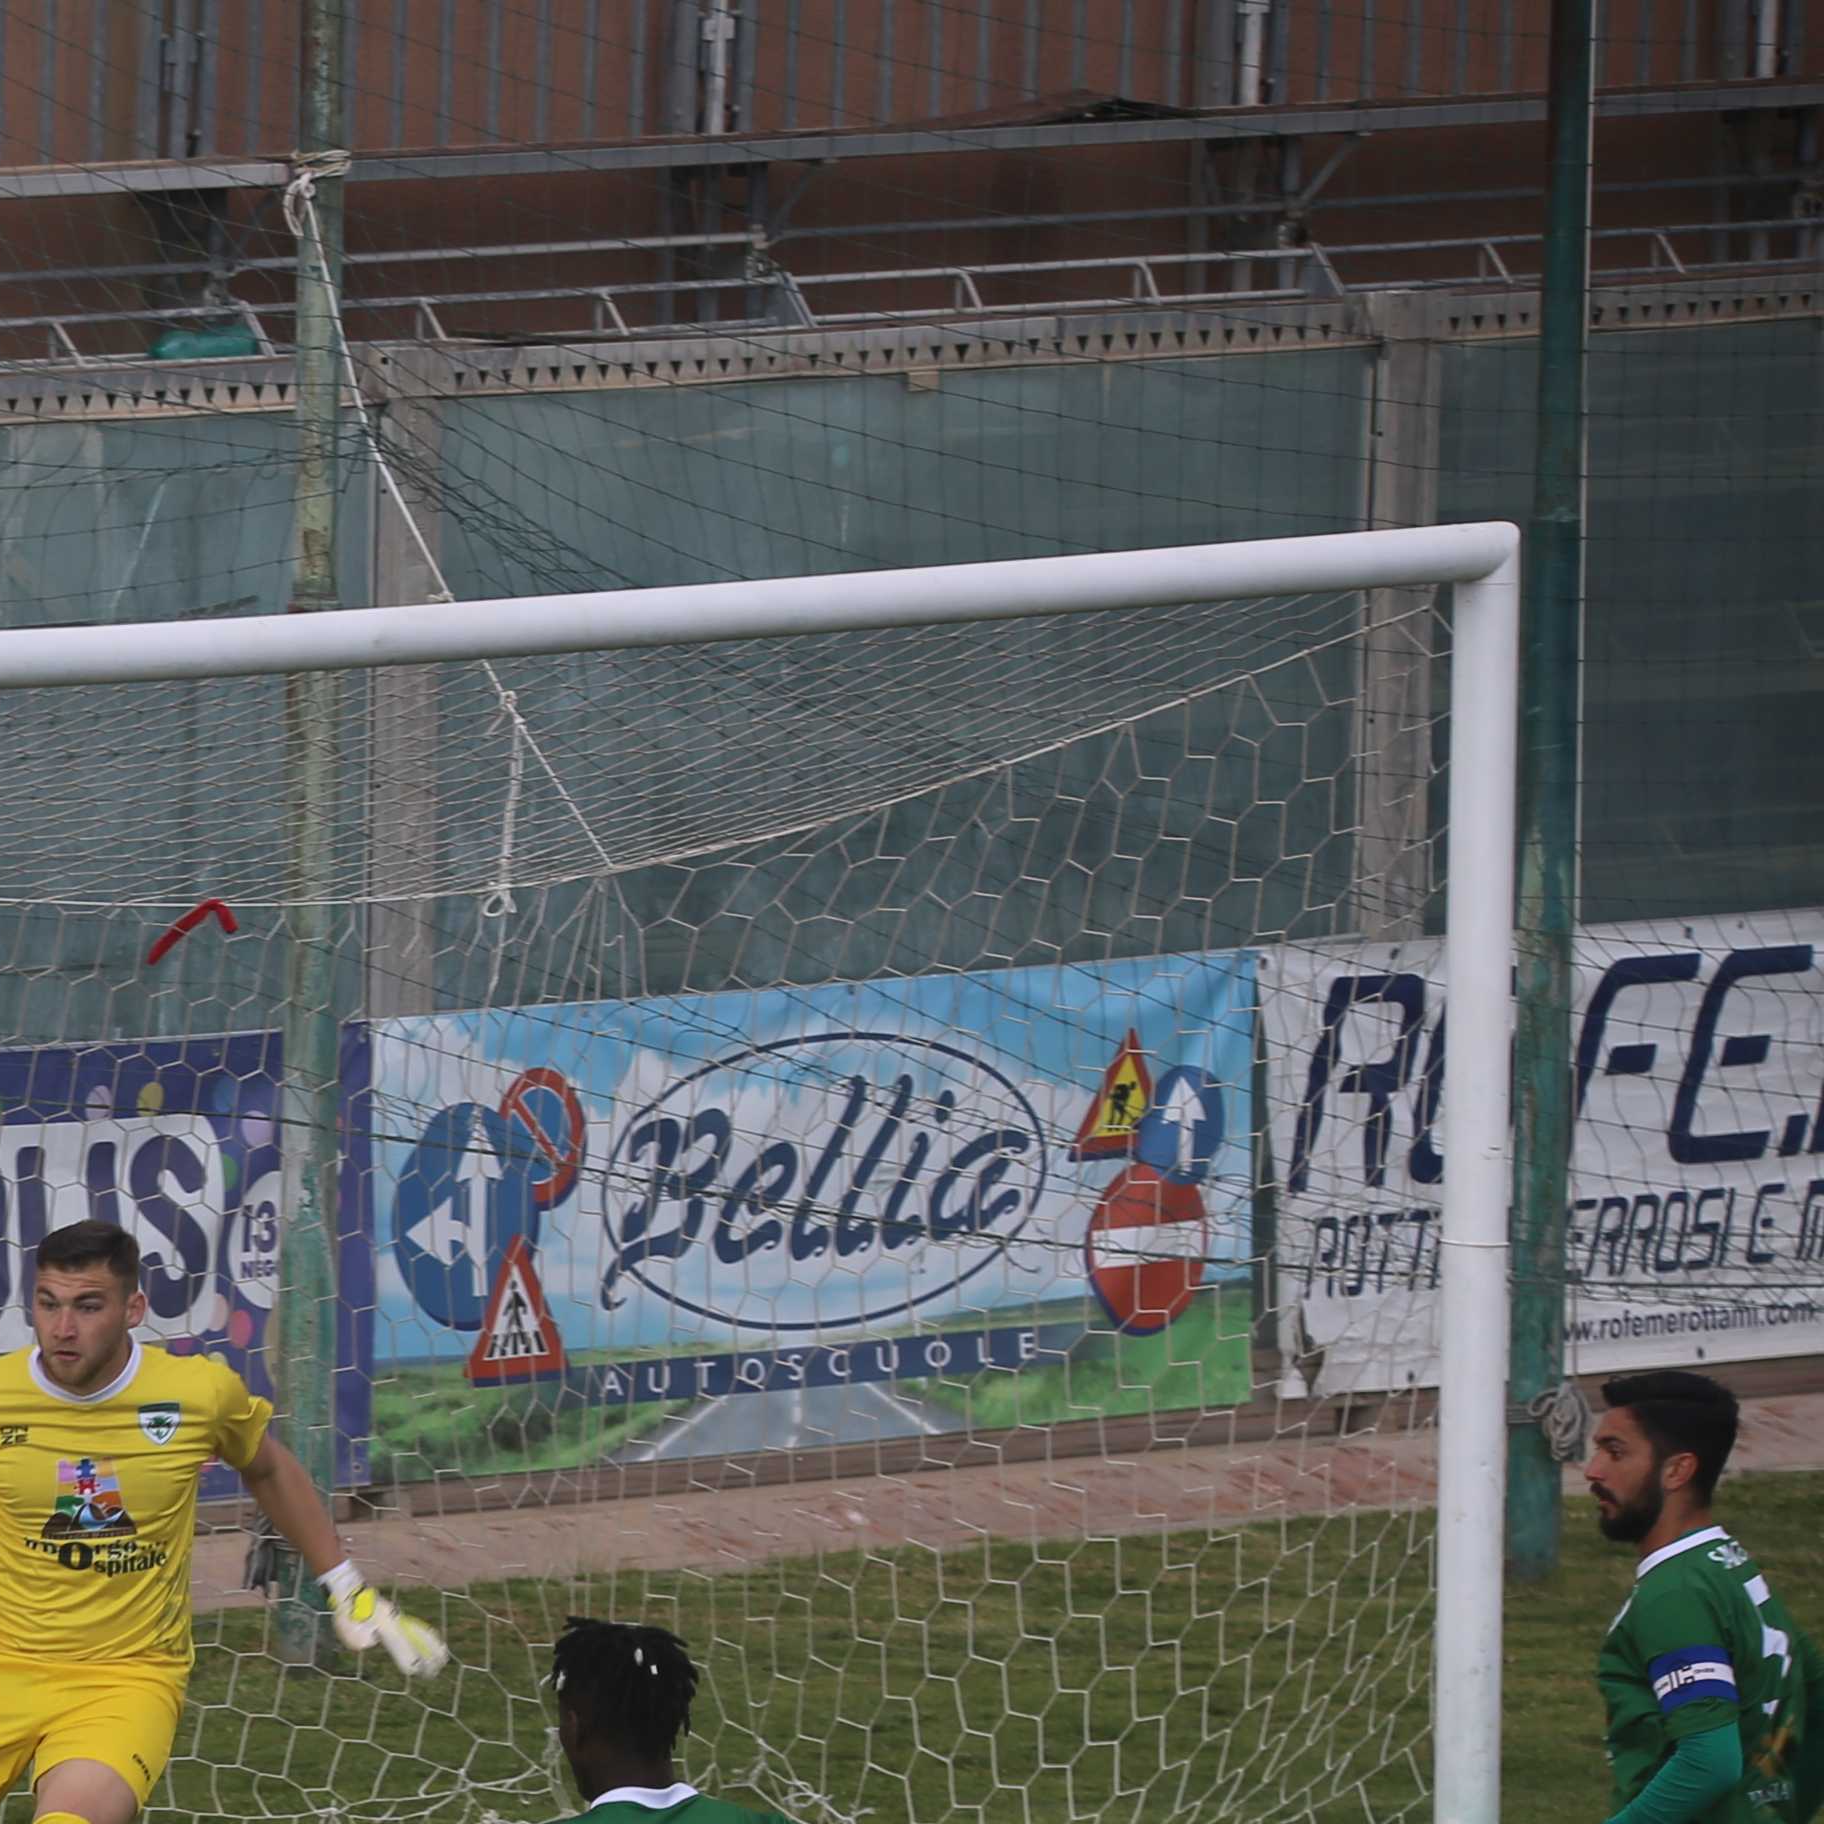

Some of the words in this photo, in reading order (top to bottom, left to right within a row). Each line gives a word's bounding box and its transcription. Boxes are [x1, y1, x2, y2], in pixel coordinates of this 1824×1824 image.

[241, 1200, 279, 1253] 13
[602, 1073, 1032, 1312] Bellia
[1566, 1186, 1736, 1277] ERROSI
[1561, 1302, 1816, 1342] ww.rofemerottami.com
[602, 1330, 1037, 1398] AUTOSCUOLE
